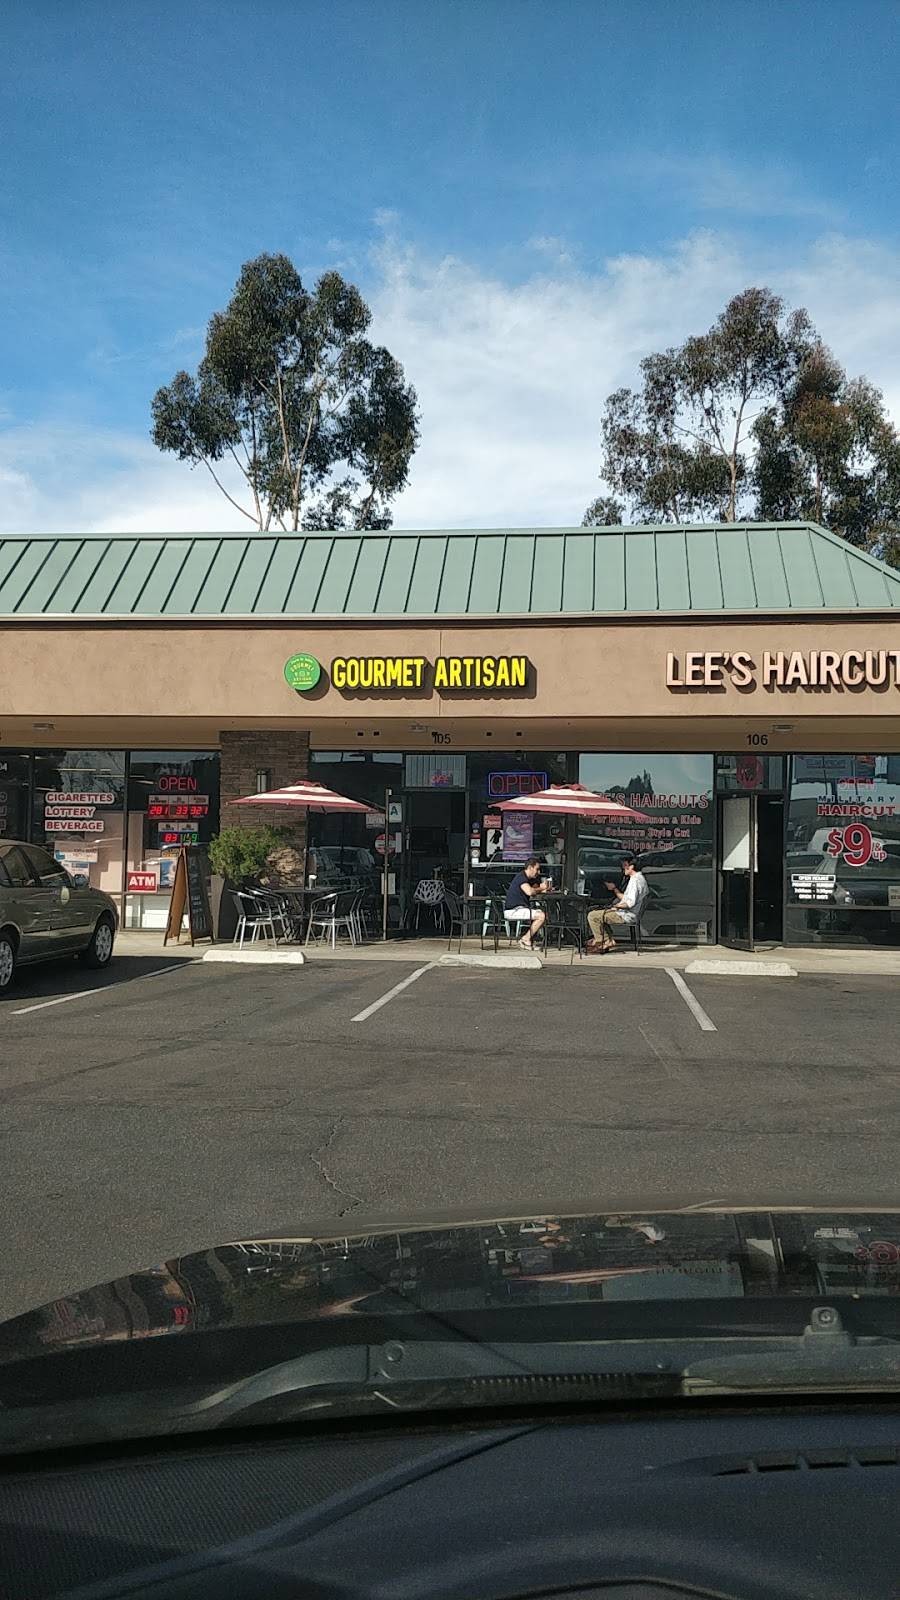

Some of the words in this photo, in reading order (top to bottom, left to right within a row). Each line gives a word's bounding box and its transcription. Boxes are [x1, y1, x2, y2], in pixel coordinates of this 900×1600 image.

[333, 658, 425, 688] GOURMET
[434, 658, 527, 687] ARTISAN
[665, 651, 753, 686] LEE'S
[433, 734, 451, 744] 105
[747, 735, 769, 746] 106
[159, 777, 197, 790] OPEN
[490, 774, 546, 795] OPEN
[46, 793, 114, 803] CIGARETTES
[631, 793, 709, 808] HAIRCUTS
[818, 795, 896, 804] MILITARY
[46, 807, 96, 817] LOTTERY
[390, 805, 399, 816] A
[817, 804, 896, 816] HAIRCUT
[680, 814, 702, 825] Kids
[46, 821, 104, 831] BEVERAGE
[673, 828, 690, 838] Cut
[872, 851, 887, 862] up
[129, 876, 156, 887] ATM
